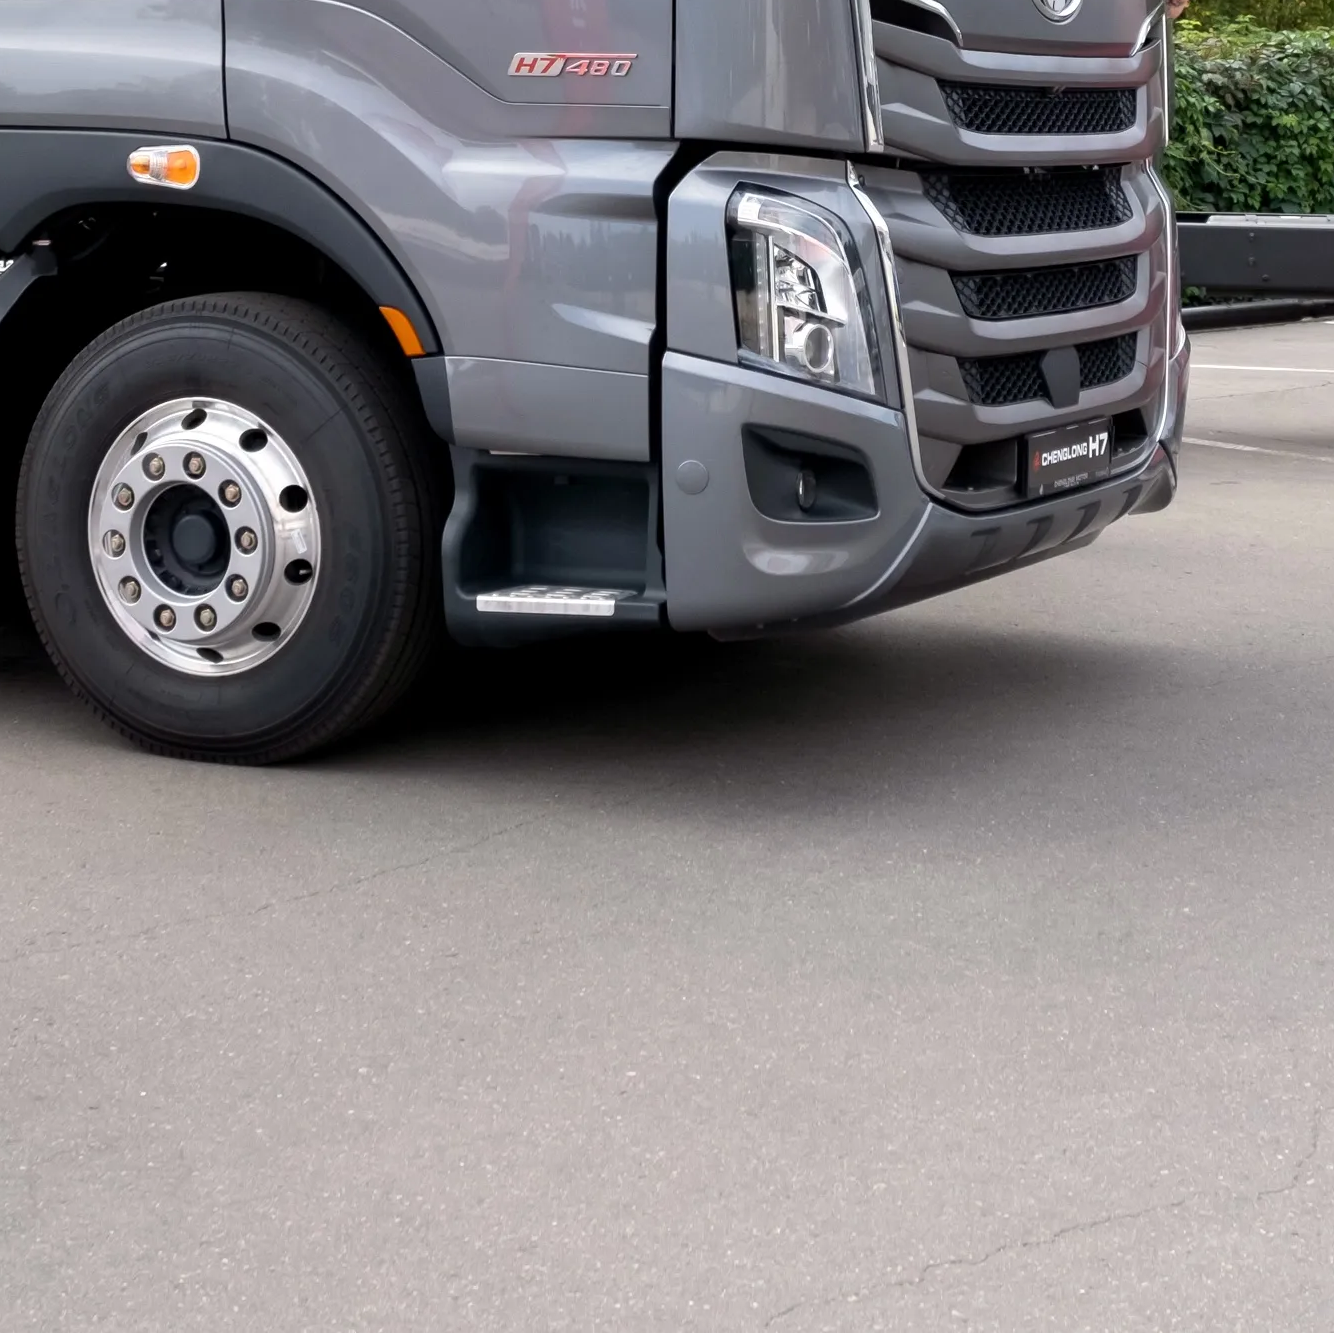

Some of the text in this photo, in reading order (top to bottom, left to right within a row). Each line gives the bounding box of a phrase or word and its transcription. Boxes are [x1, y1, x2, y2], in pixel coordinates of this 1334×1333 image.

[514, 57, 633, 76] H7 480
[1041, 432, 1108, 467] CHENGLONG H7
